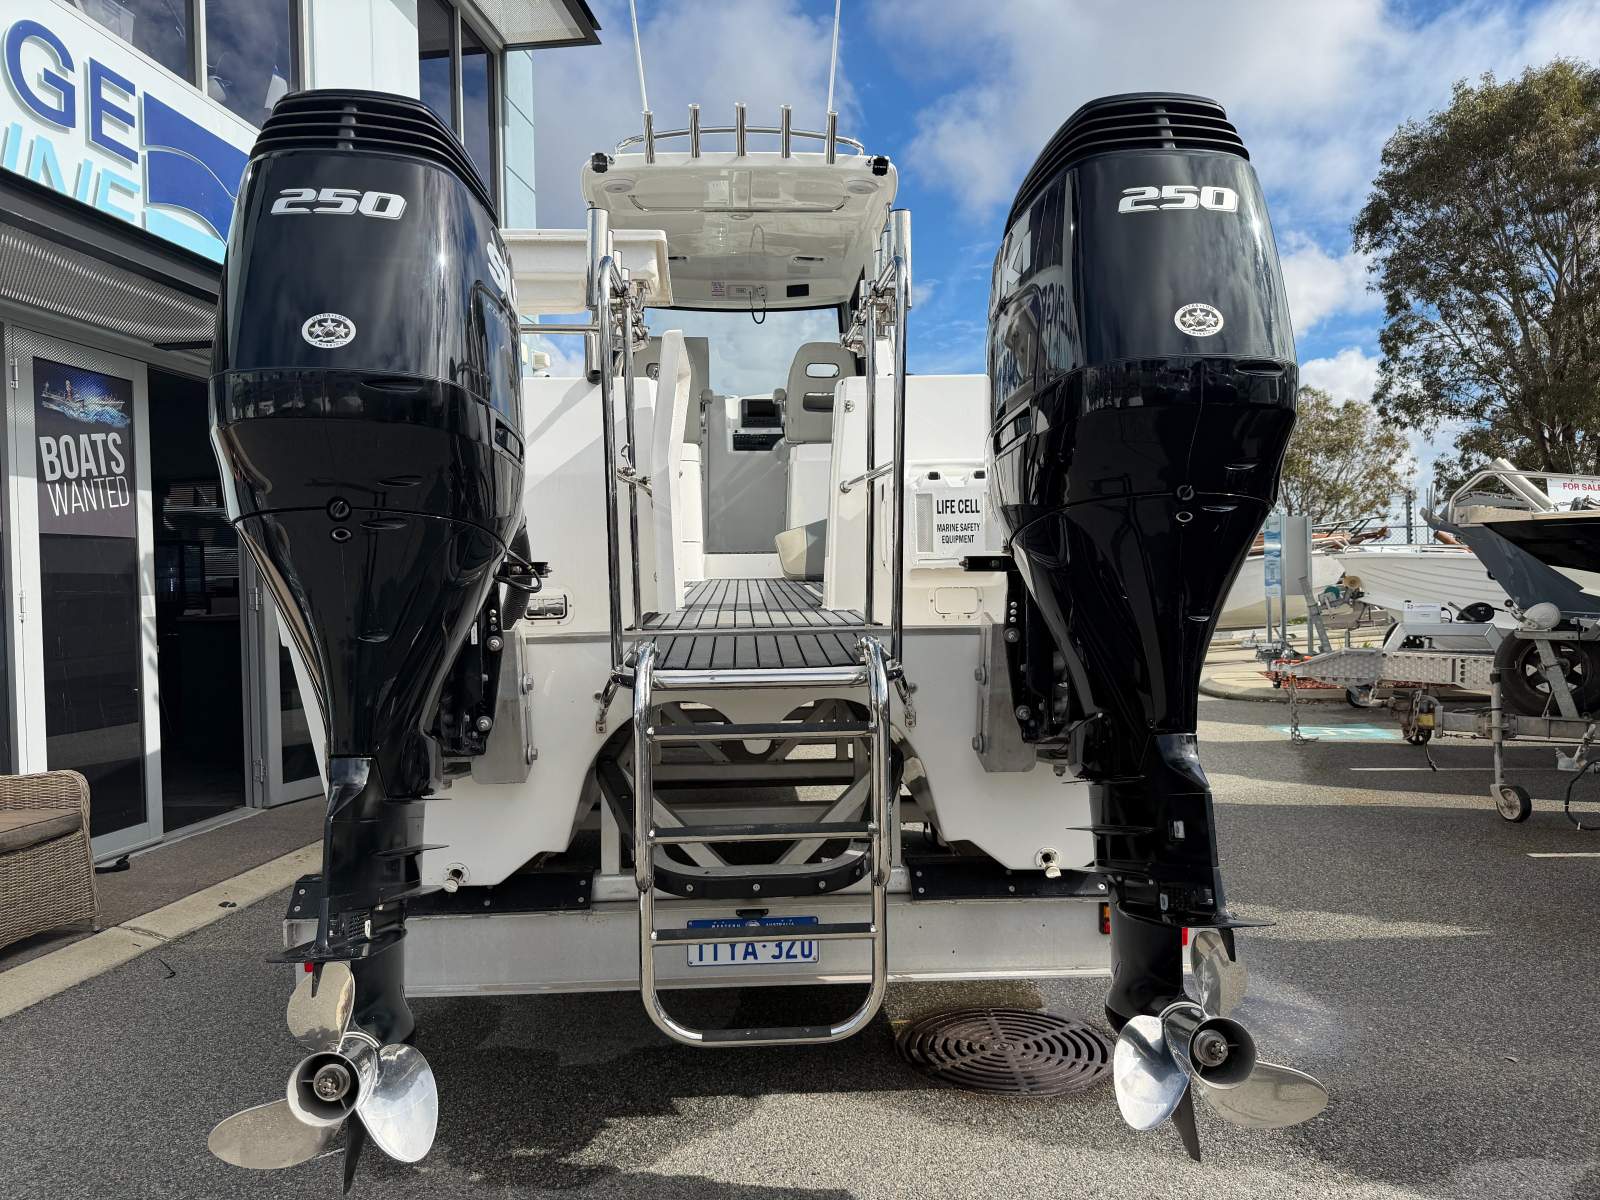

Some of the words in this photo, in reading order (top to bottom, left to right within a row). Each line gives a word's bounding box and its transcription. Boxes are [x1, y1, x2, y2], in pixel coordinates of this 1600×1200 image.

[5, 19, 139, 164] GE
[270, 188, 407, 220] 250
[1118, 185, 1239, 213] 250
[39, 432, 126, 481] BOATS
[47, 476, 130, 517] WANTED
[936, 499, 956, 515] LIFE
[957, 499, 980, 514] CELL
[936, 523, 959, 533] MARINE
[959, 523, 981, 532] SAFETY
[941, 535, 975, 544] EQUIPMENT
